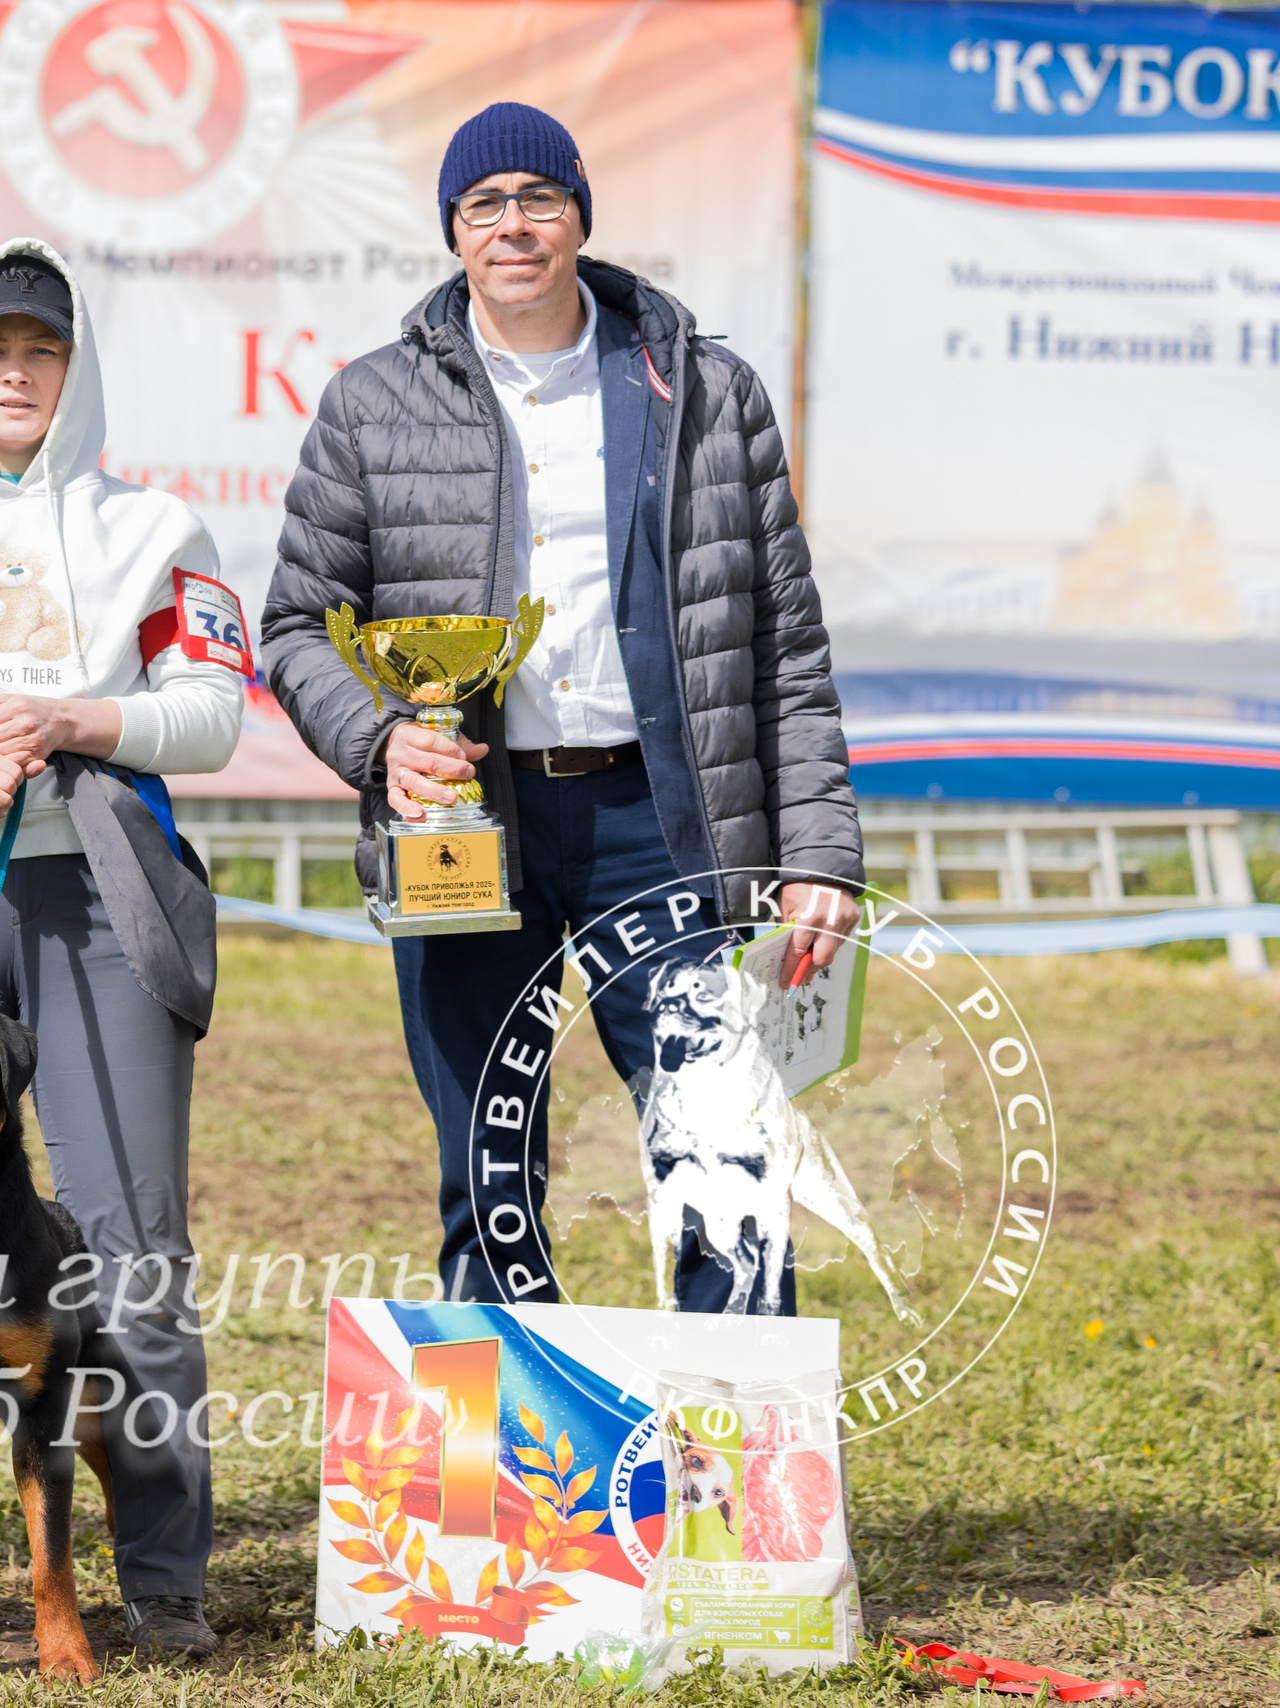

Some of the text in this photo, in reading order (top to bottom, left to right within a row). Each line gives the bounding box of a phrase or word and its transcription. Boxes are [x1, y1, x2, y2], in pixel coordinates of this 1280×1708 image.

[1008, 315, 1214, 363] Нижний
[196, 610, 243, 651] 36
[22, 667, 62, 685] THERE
[431, 882, 474, 891] ПРИВОЛЖЬЯ
[408, 890, 493, 903] ЛУЧШИЙ ЮНИОР СУКА
[412, 1336, 502, 1539] 1
[616, 1416, 659, 1507] РОТВЕЙ
[677, 1581, 700, 1589] 100%
[694, 1600, 795, 1609] СБАЛАНСИРОВАННЫЙ КОРМ
[694, 1609, 712, 1617] ДЛЯ
[713, 1609, 756, 1617] ВЗРОСЛЫХ
[758, 1610, 784, 1618] СОБАК
[733, 1618, 761, 1626] ПОРОД
[704, 1631, 763, 1641] ЯГНЕНКОМ
[810, 1634, 818, 1644] 3
